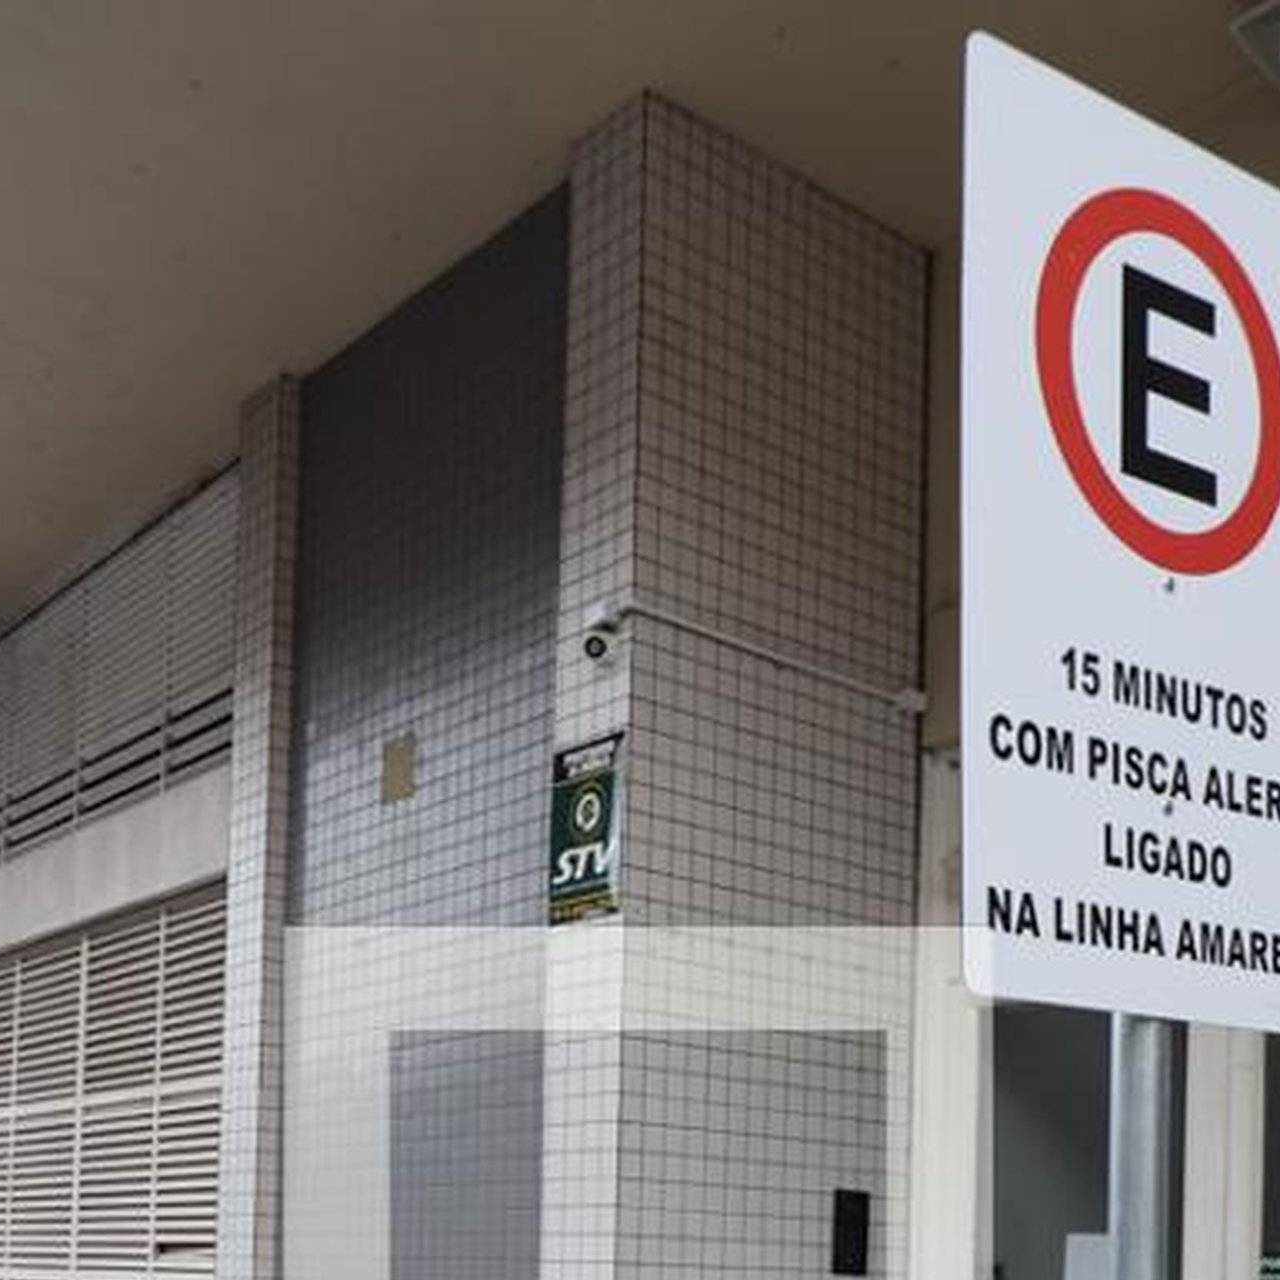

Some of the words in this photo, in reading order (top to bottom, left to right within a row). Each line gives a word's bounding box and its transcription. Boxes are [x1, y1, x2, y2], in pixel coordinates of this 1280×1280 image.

[1122, 263, 1218, 509] E
[1061, 646, 1101, 697] 15
[1113, 660, 1268, 741] MINUTOS
[989, 713, 1074, 775] COM
[1088, 736, 1192, 801] PISCA
[551, 840, 616, 885] STV
[1104, 822, 1232, 888] LIGADO
[986, 885, 1041, 939] NA
[1054, 896, 1166, 957] LINHA
